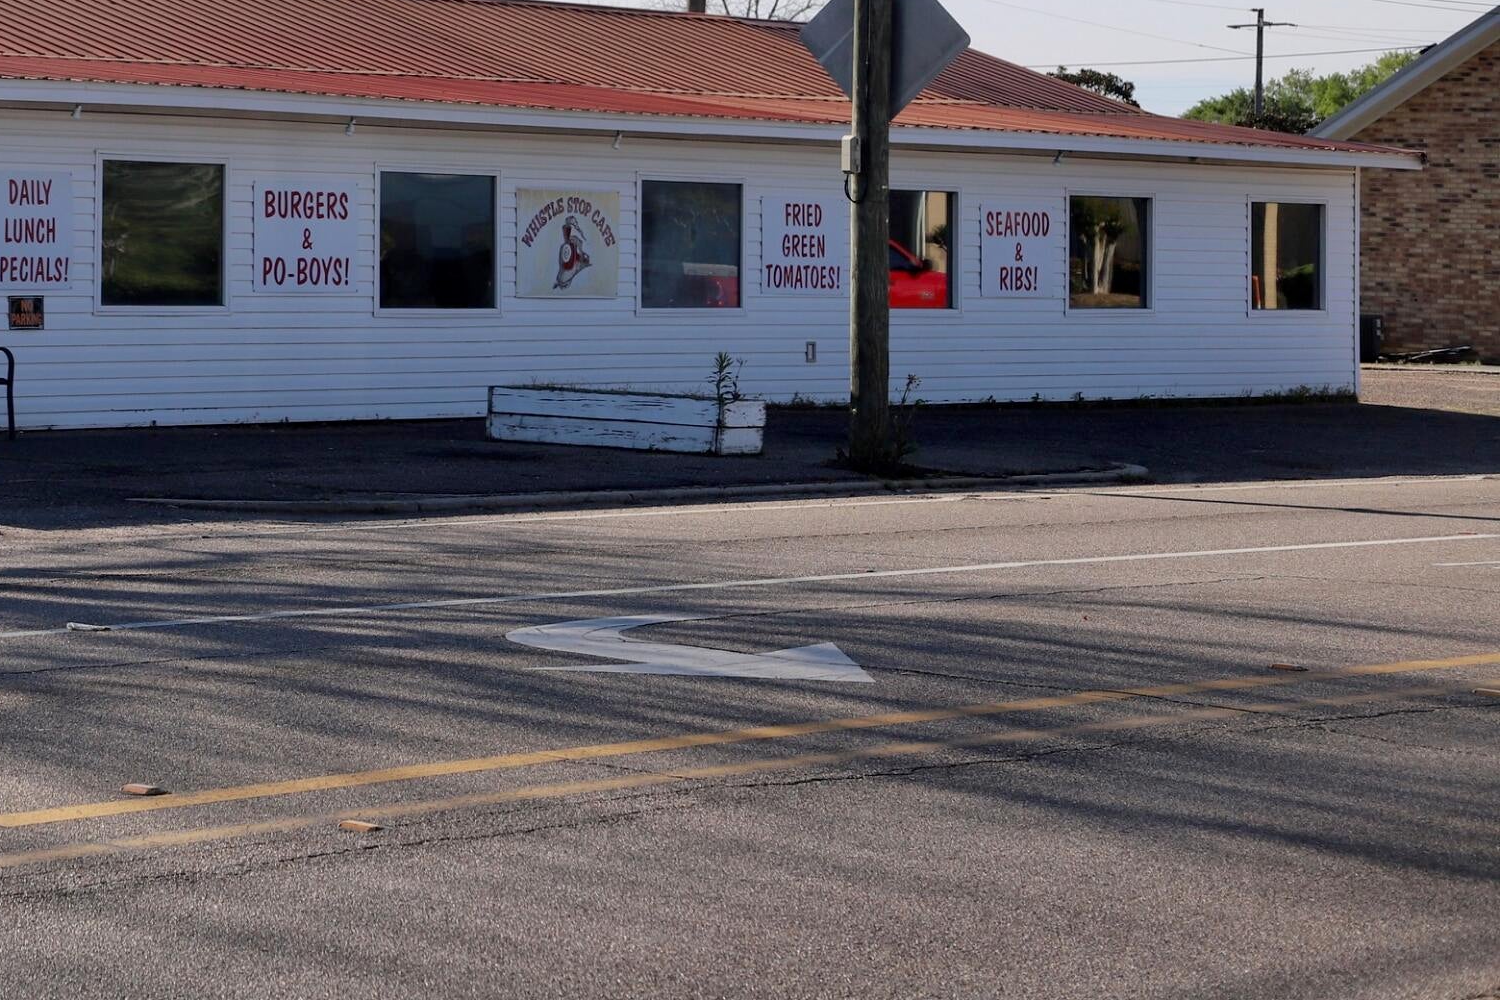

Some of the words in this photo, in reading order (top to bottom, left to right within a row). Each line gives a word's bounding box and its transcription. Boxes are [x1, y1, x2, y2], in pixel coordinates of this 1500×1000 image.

[8, 179, 53, 206] DAILY
[264, 190, 349, 220] BURGERS
[521, 198, 565, 247] WHISTLE
[567, 197, 592, 217] STOP
[591, 209, 616, 247] CAFE
[785, 203, 822, 227] FRIED
[986, 211, 1050, 237] SEAFOOD
[4, 217, 56, 244] LUNCH
[302, 228, 313, 250] &
[782, 234, 825, 258] GREEN
[1015, 242, 1023, 262] &
[263, 256, 350, 286] PO-BOYS!
[765, 264, 840, 290] TOMATOES!
[1000, 266, 1038, 291] RIBS!
